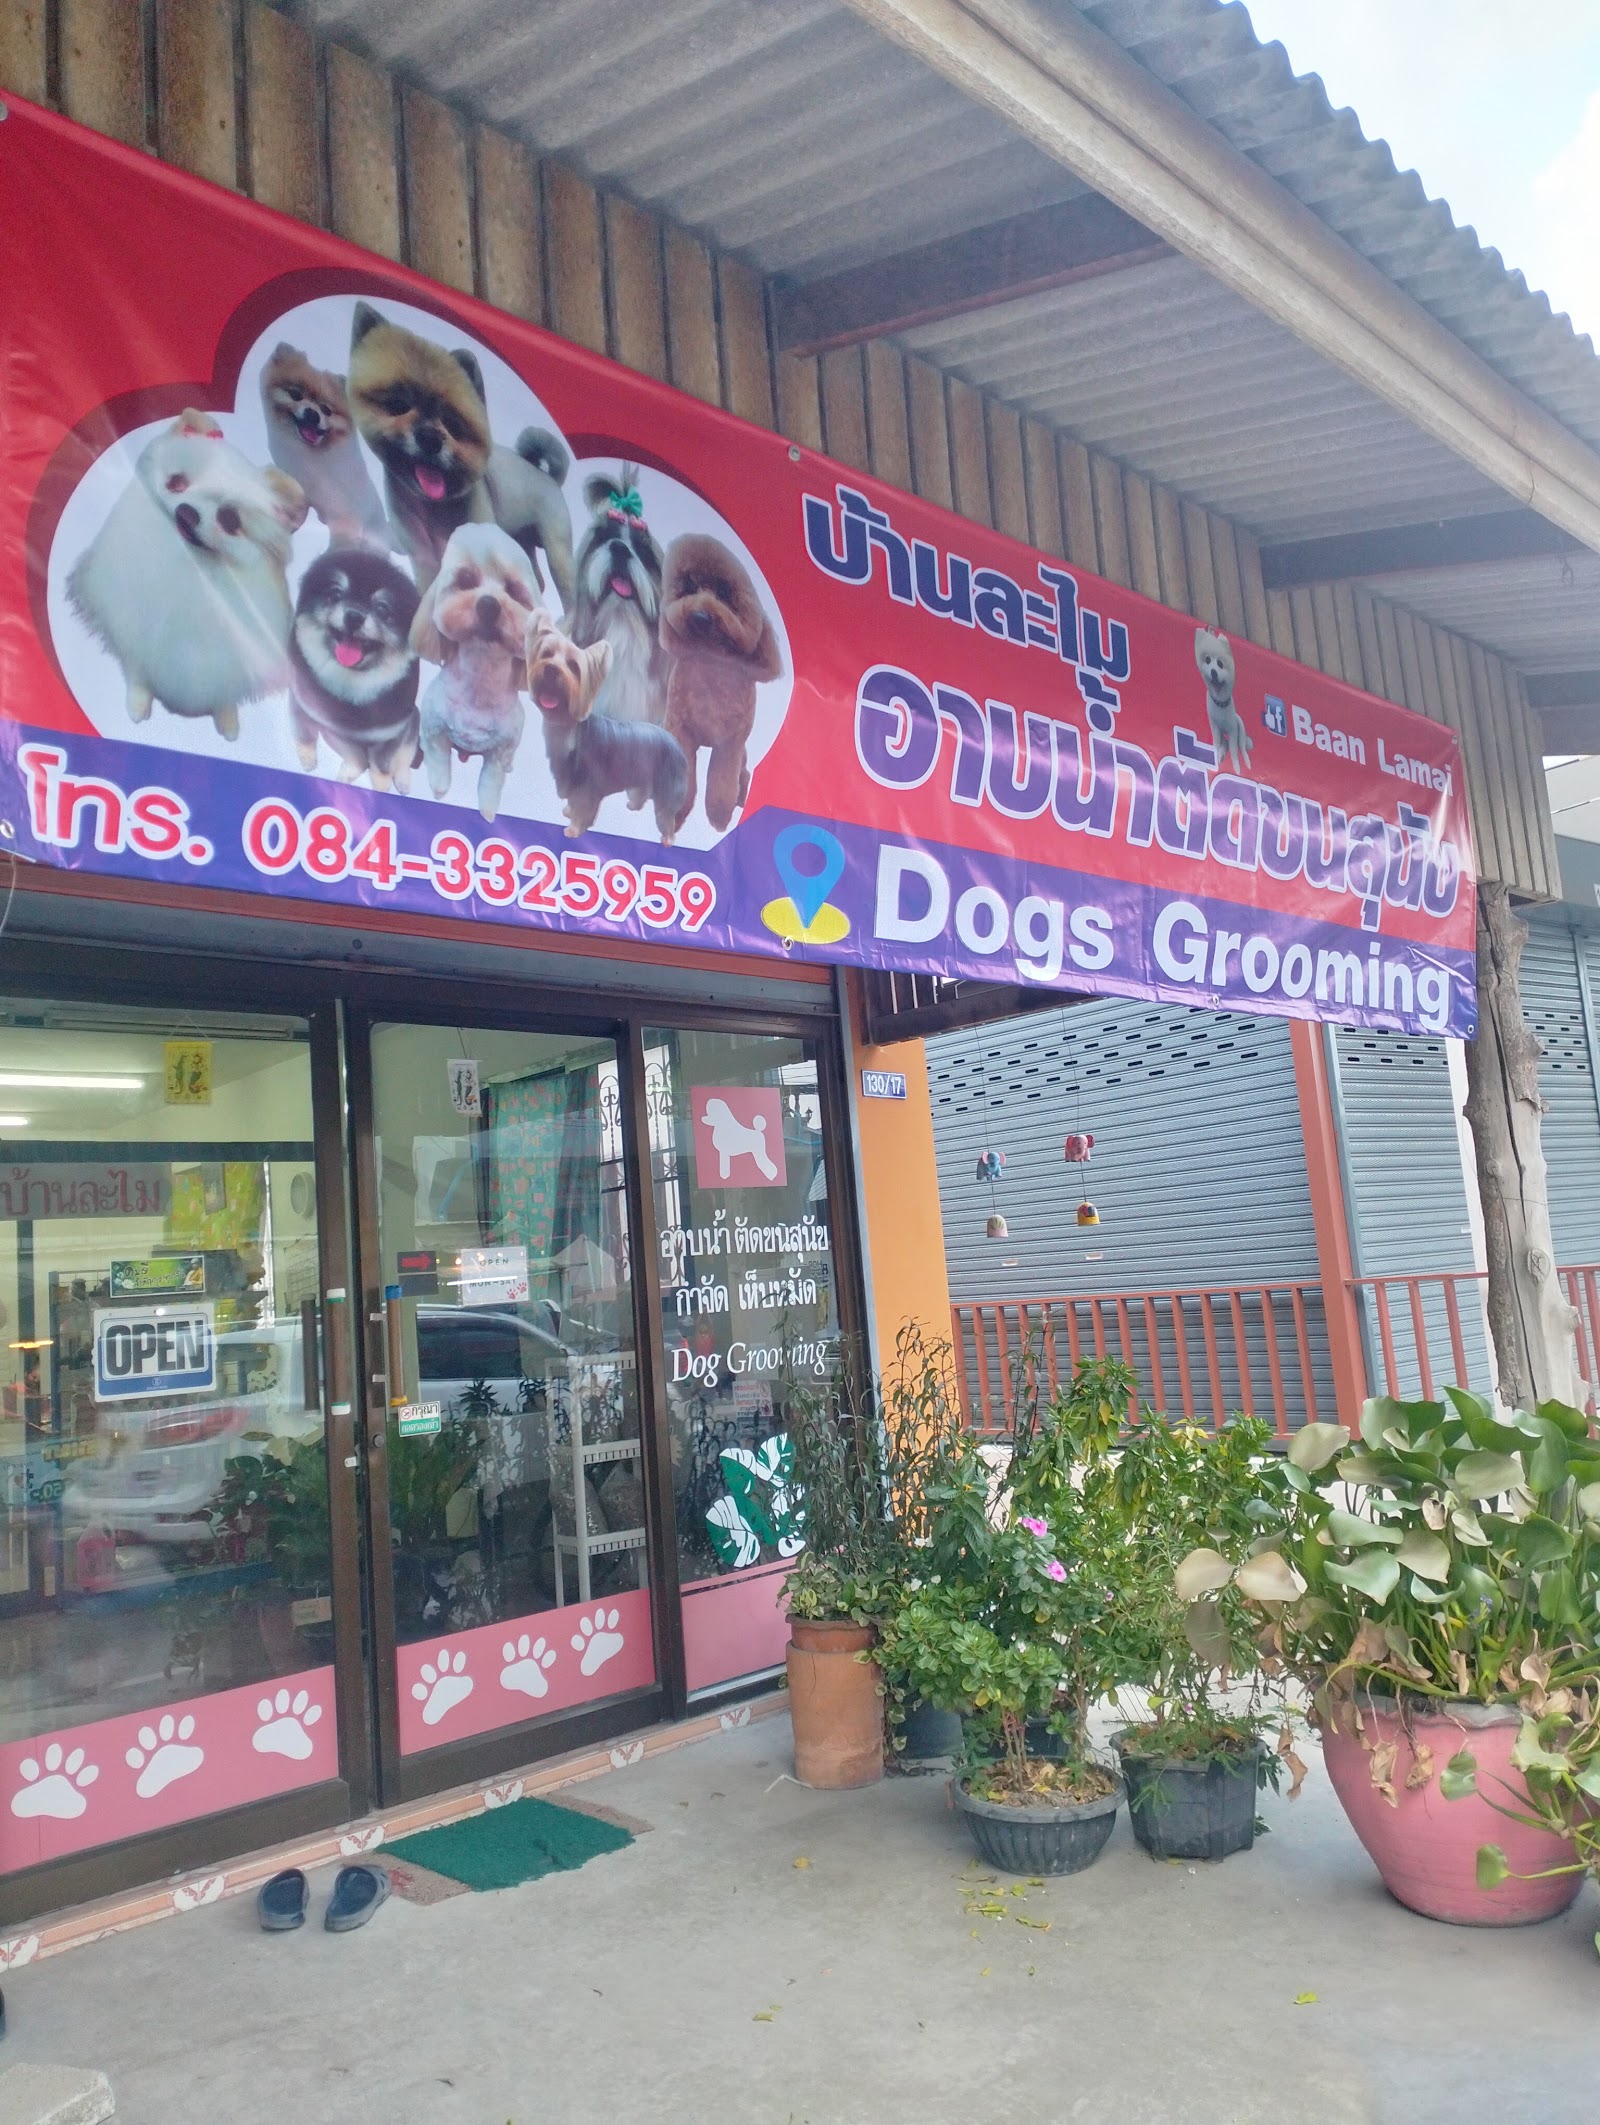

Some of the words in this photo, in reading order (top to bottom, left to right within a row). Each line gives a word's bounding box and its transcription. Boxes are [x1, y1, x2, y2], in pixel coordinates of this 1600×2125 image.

[802, 484, 1130, 682] บ้านละไม
[1292, 704, 1365, 765] Baan
[1377, 738, 1453, 796] Lamai
[855, 664, 1460, 932] อาบน้ำตัดขนสุนัข
[17, 743, 213, 865] โทร.
[242, 798, 716, 933] 084-3325959
[873, 845, 1115, 981] Dogs
[1153, 901, 1451, 1031] Grooming
[867, 1074, 902, 1095] 130/17
[0, 1167, 160, 1216] บ้านละไม
[660, 1209, 731, 1257] อาบน้ำ
[480, 1258, 509, 1266] OPEN
[676, 1274, 729, 1316] กำจัด
[106, 1320, 205, 1376] OPEN
[671, 1346, 721, 1387] Dog
